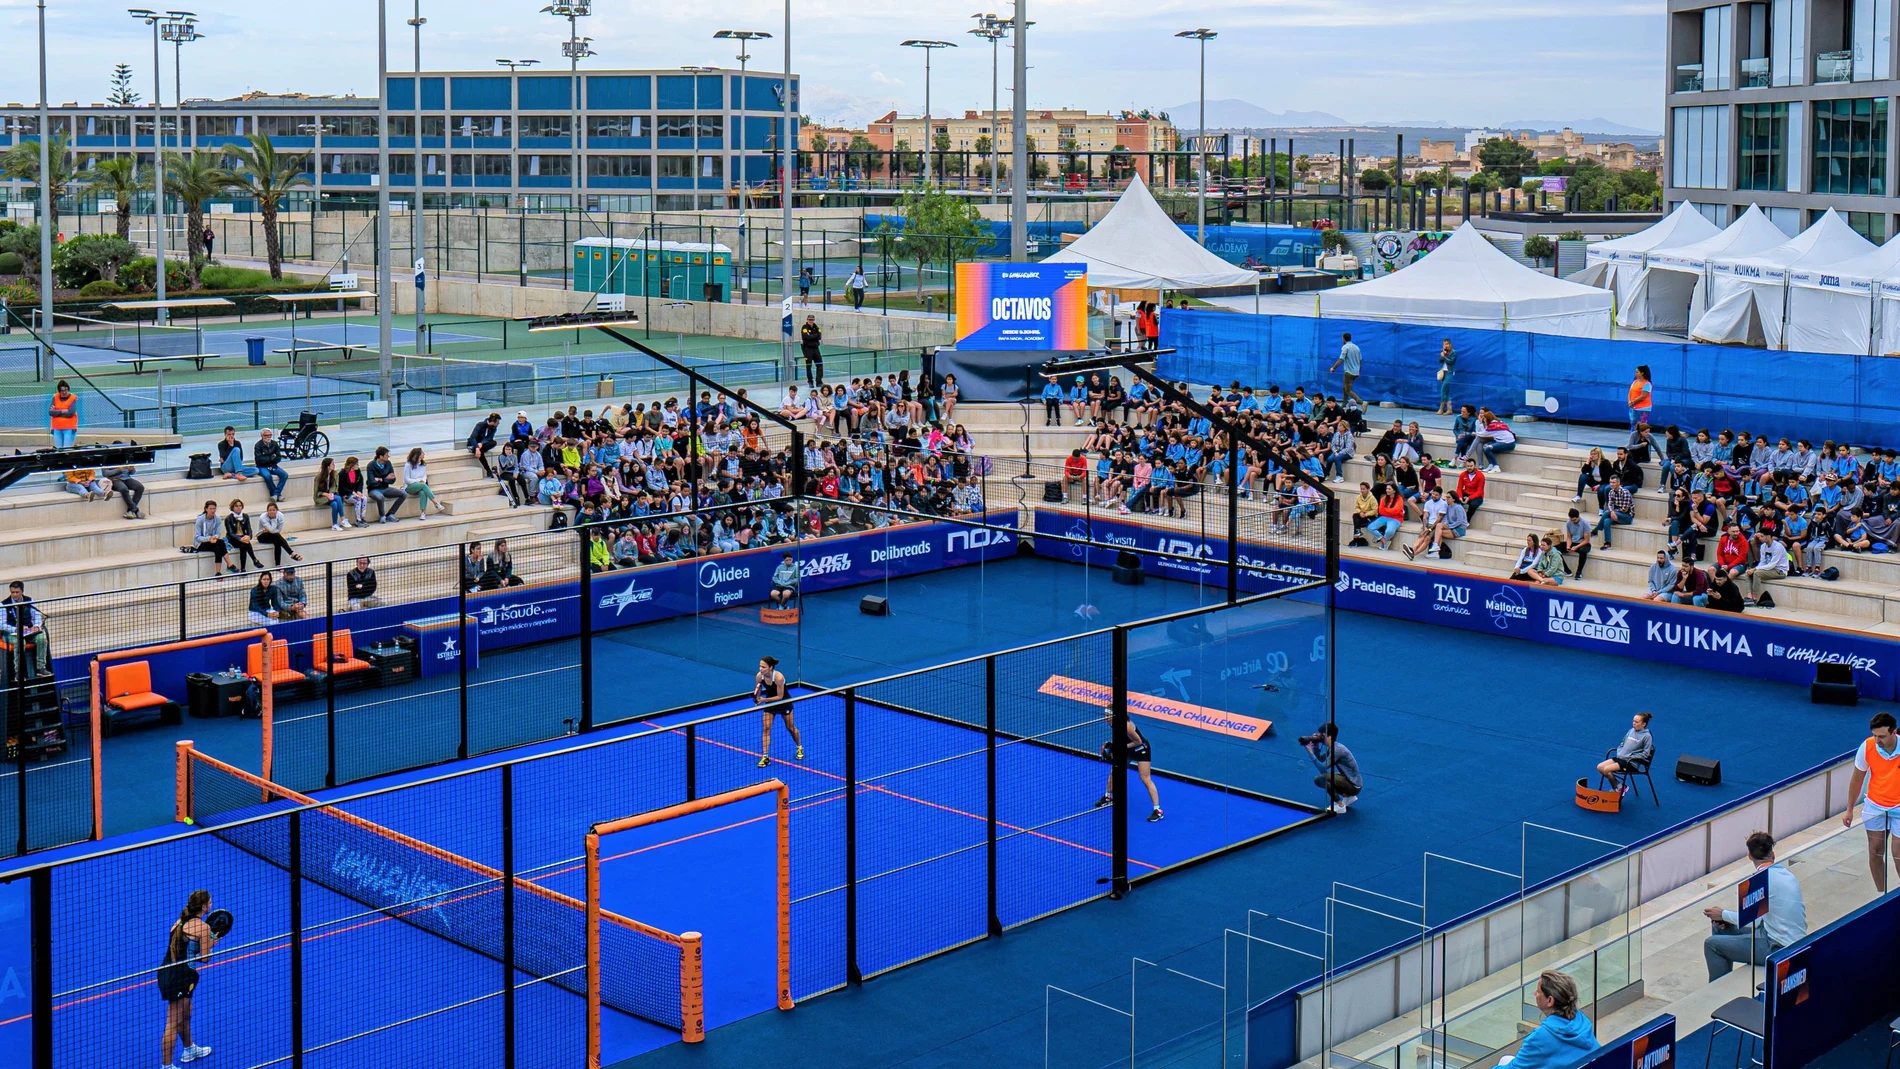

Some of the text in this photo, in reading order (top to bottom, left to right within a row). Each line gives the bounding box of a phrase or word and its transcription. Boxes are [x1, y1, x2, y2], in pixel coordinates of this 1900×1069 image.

[1206, 242, 1249, 254] ACADEMY
[1734, 264, 1760, 278] KUIKMA
[785, 303, 791, 311] 2
[992, 297, 1052, 321] OCTAVOS
[871, 541, 931, 563] Delibreads
[706, 566, 750, 586] Midea
[800, 561, 852, 578] UESTRO
[1352, 578, 1416, 600] PadelGalis
[1433, 583, 1471, 605] TAU
[1485, 599, 1528, 615] Mallorca
[1549, 599, 1630, 629] MAX
[1550, 618, 1630, 643] COLCHON
[1647, 620, 1753, 657] KUIKMA
[1786, 646, 1881, 677] CHALLENGER
[1050, 682, 1258, 734] TAU CERÁMIC MALLORCA CHALLENGER
[1637, 1044, 1670, 1069] PLAYTOMIC
